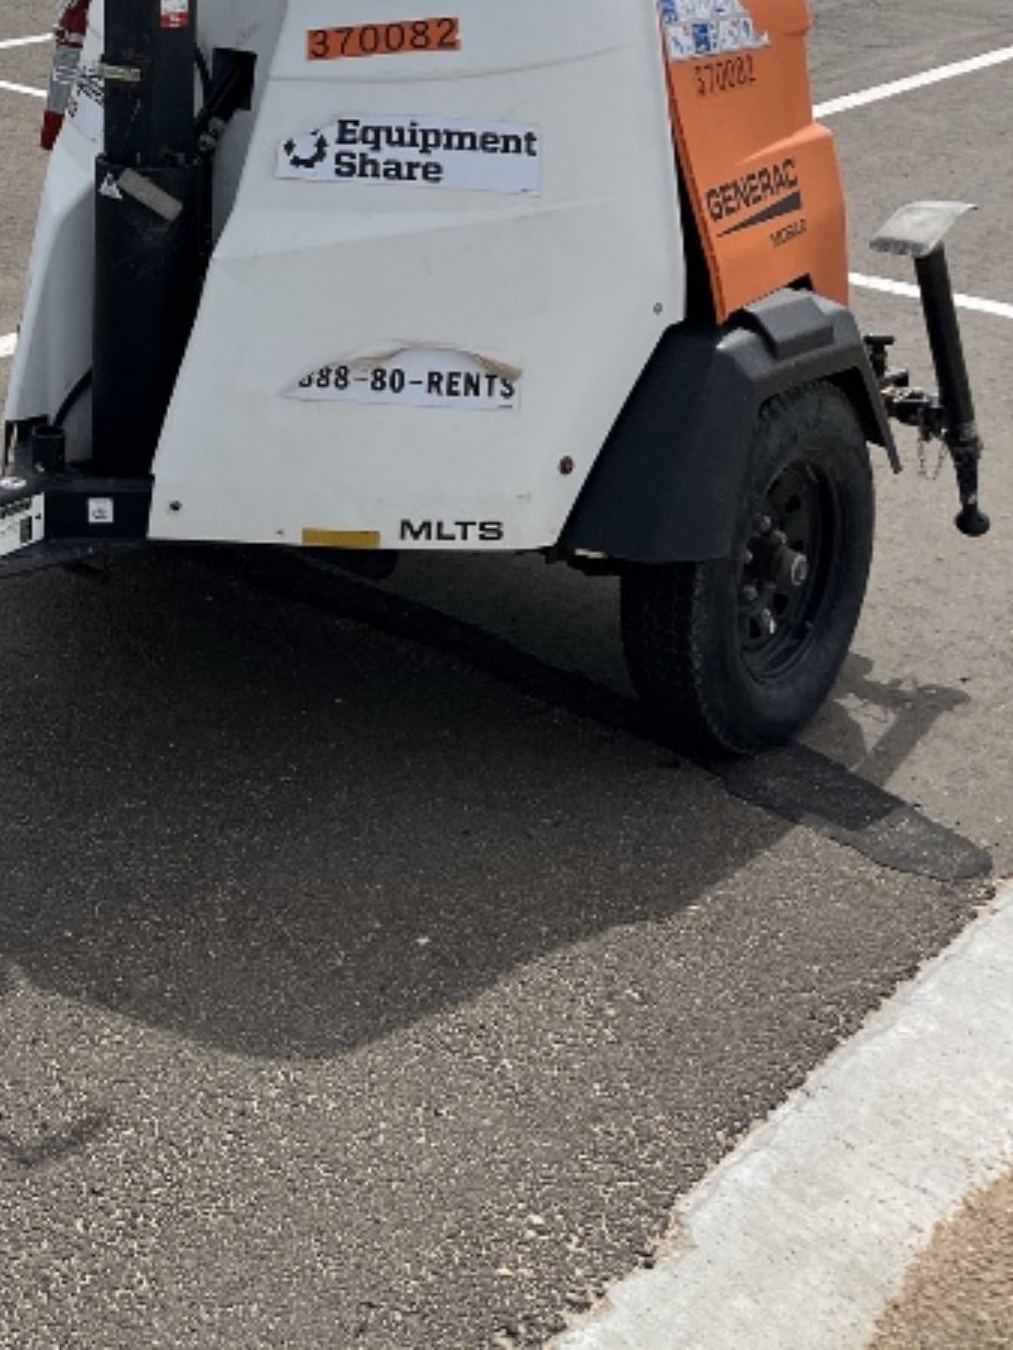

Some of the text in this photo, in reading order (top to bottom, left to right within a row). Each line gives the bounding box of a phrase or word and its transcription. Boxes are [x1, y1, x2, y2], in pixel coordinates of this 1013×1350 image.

[310, 17, 460, 60] 370082
[335, 119, 538, 157] Equipment
[333, 152, 444, 183] Share
[705, 157, 799, 222] GENERAC
[399, 518, 506, 542] MLTS
